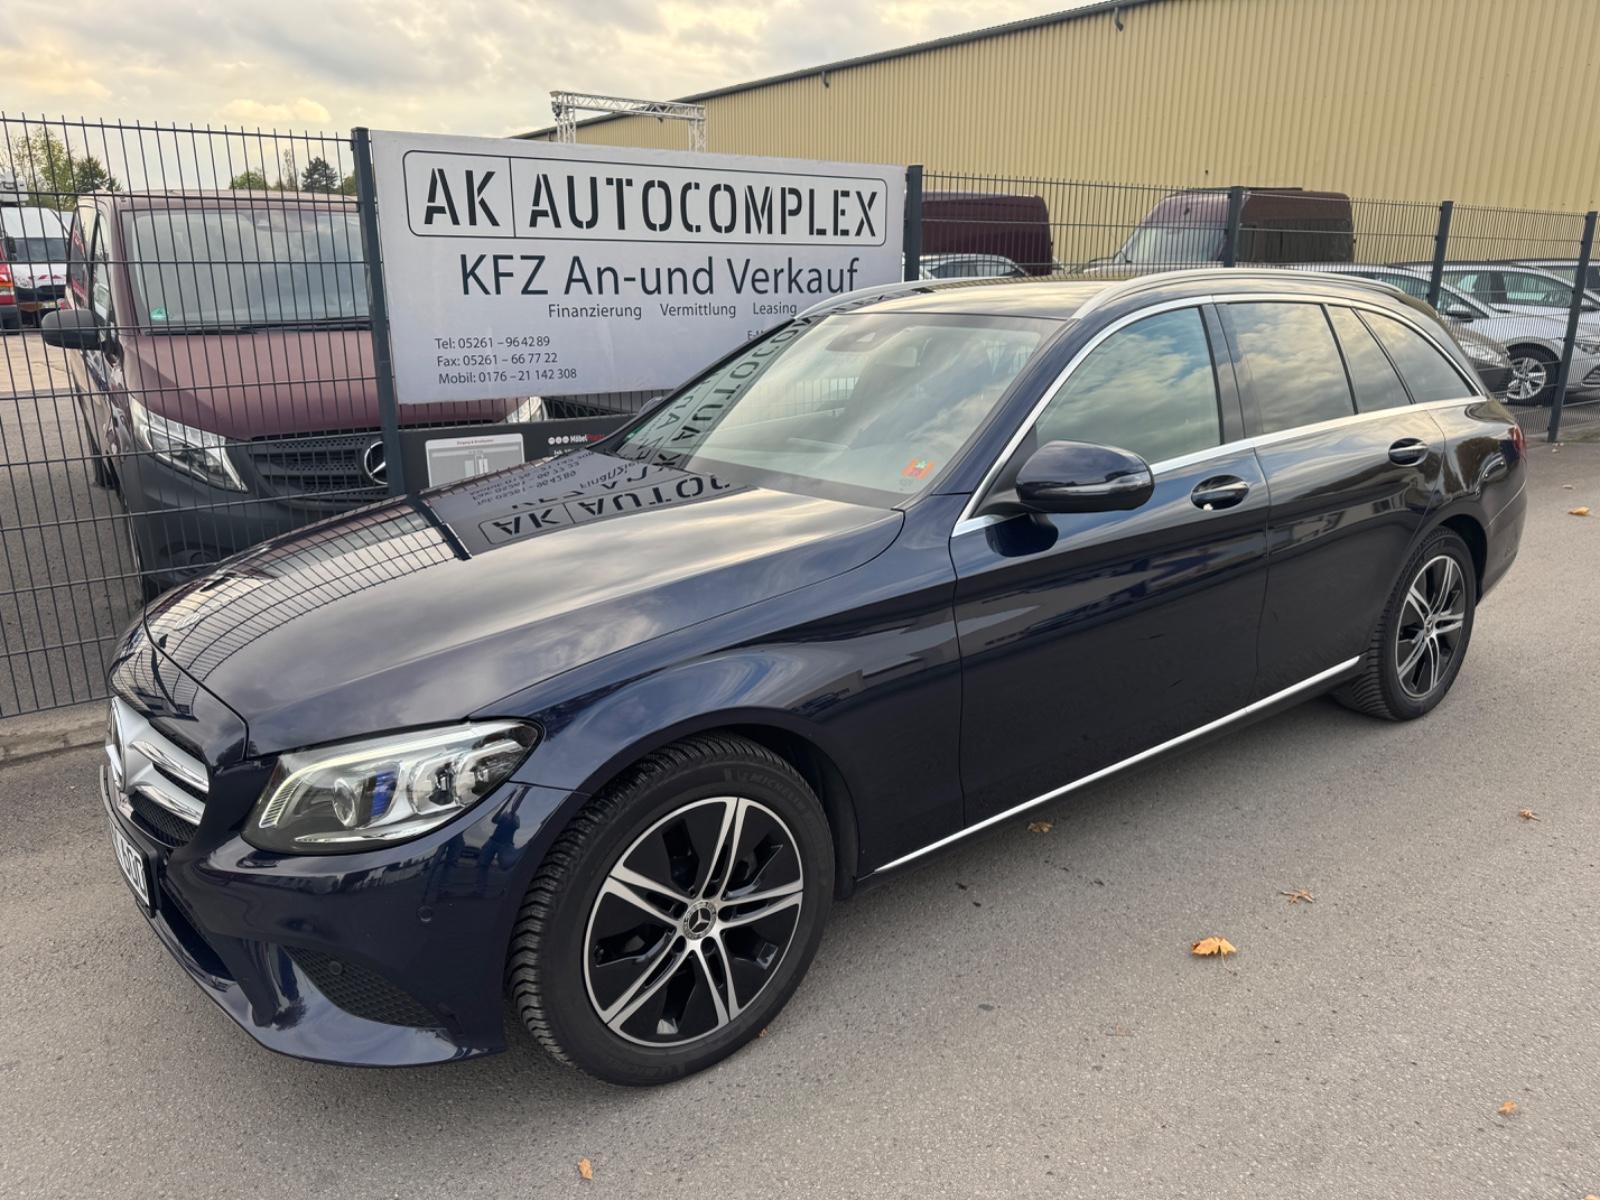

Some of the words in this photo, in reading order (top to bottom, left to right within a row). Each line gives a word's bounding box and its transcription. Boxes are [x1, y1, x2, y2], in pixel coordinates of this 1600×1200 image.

[424, 167, 500, 227] AK
[529, 172, 877, 237] AUTOCOMPLEX
[460, 253, 548, 296] KFZ
[564, 254, 714, 296] An-und
[726, 256, 859, 295] Verkauf
[549, 302, 642, 320] Finanzierung
[660, 302, 736, 318] Vermittlung
[752, 301, 797, 316] Leasing
[434, 337, 456, 349] Tel:
[458, 337, 493, 348] 05261
[437, 355, 461, 367] Fax:
[463, 354, 498, 366] 05261
[438, 371, 476, 384] Mobil:
[478, 370, 507, 383] 0176
